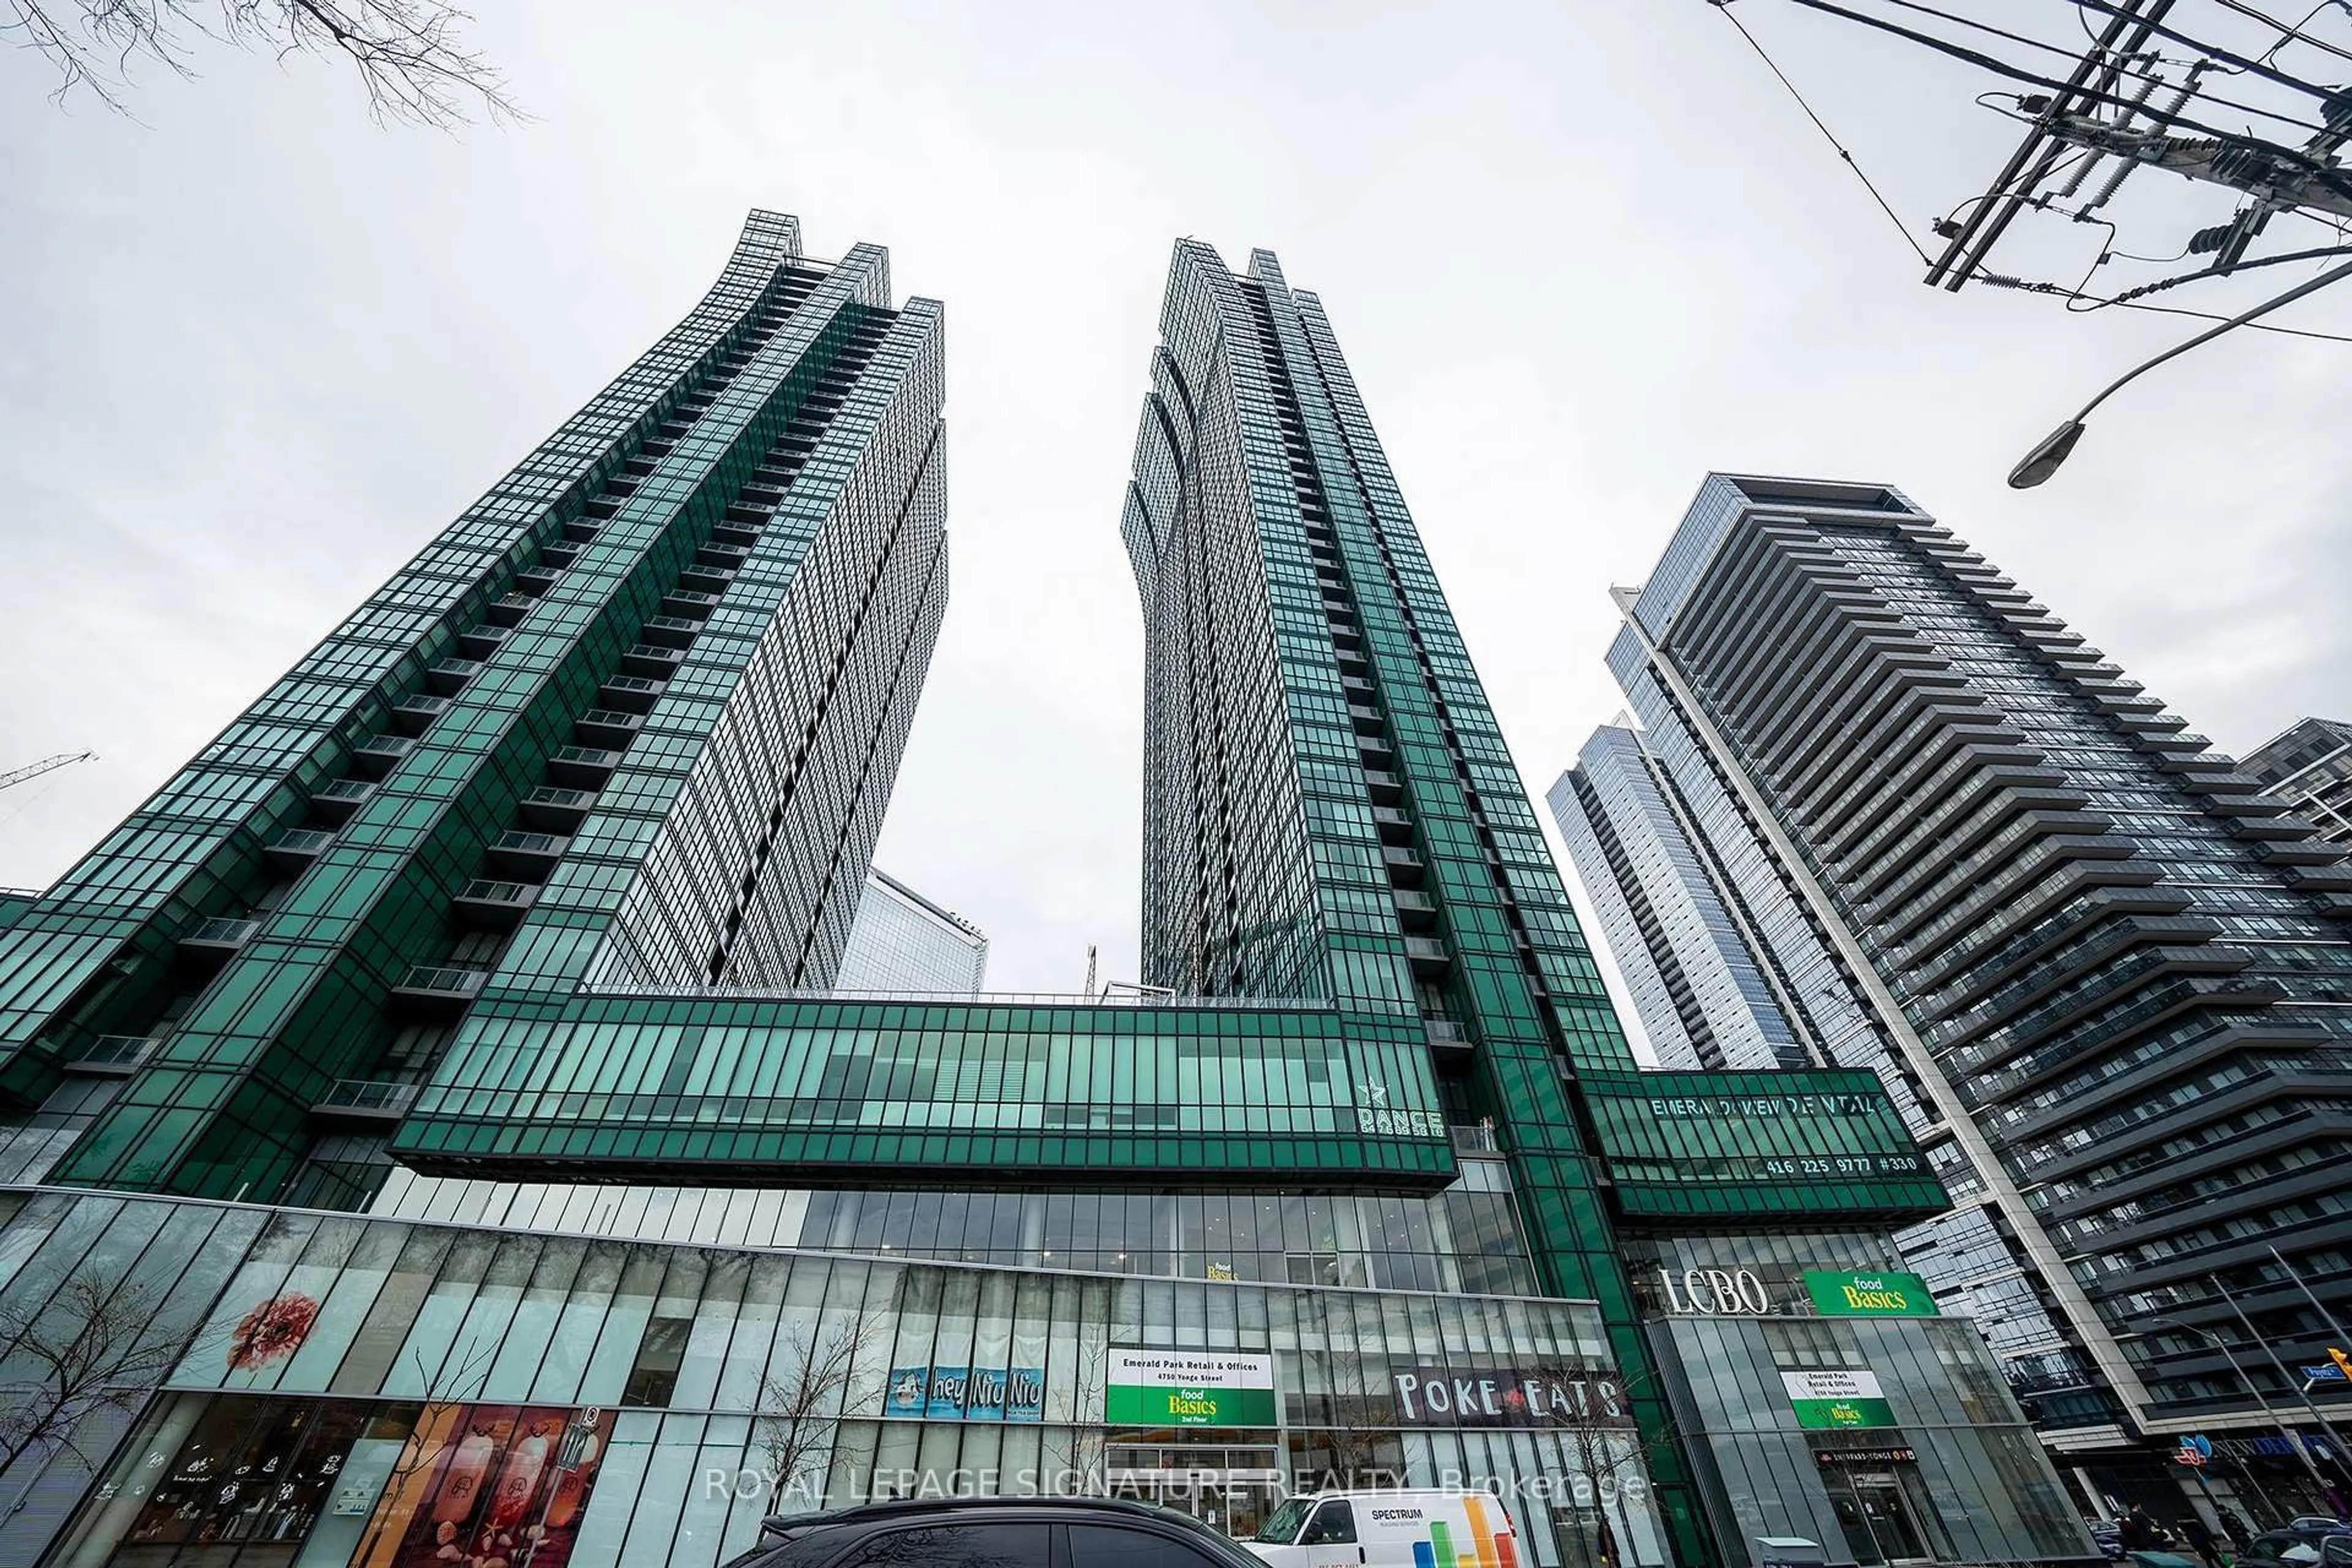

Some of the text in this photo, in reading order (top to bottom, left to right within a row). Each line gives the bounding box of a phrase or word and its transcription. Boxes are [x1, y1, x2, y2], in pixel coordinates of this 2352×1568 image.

[1651, 1098, 1730, 1115] EMERAD
[1741, 1099, 1780, 1115] VIEW
[1357, 1108, 1444, 1128] DANCE
[1766, 1157, 1917, 1174] 416 225 9777 #330
[1215, 1262, 1231, 1271] food
[1657, 1267, 1769, 1315] LCBO
[1854, 1276, 1883, 1290] food
[1842, 1285, 1907, 1310] Basics
[1123, 1359, 1160, 1368] Emerald
[1164, 1360, 1184, 1369] Park
[1227, 1362, 1257, 1371] Offices
[932, 1370, 1041, 1408] hey Niu Niu
[1181, 1389, 1204, 1400] food
[1395, 1374, 1621, 1420] POKE EATS
[1168, 1395, 1216, 1415] Basics
[1372, 1509, 1423, 1520] SPECTRUM
